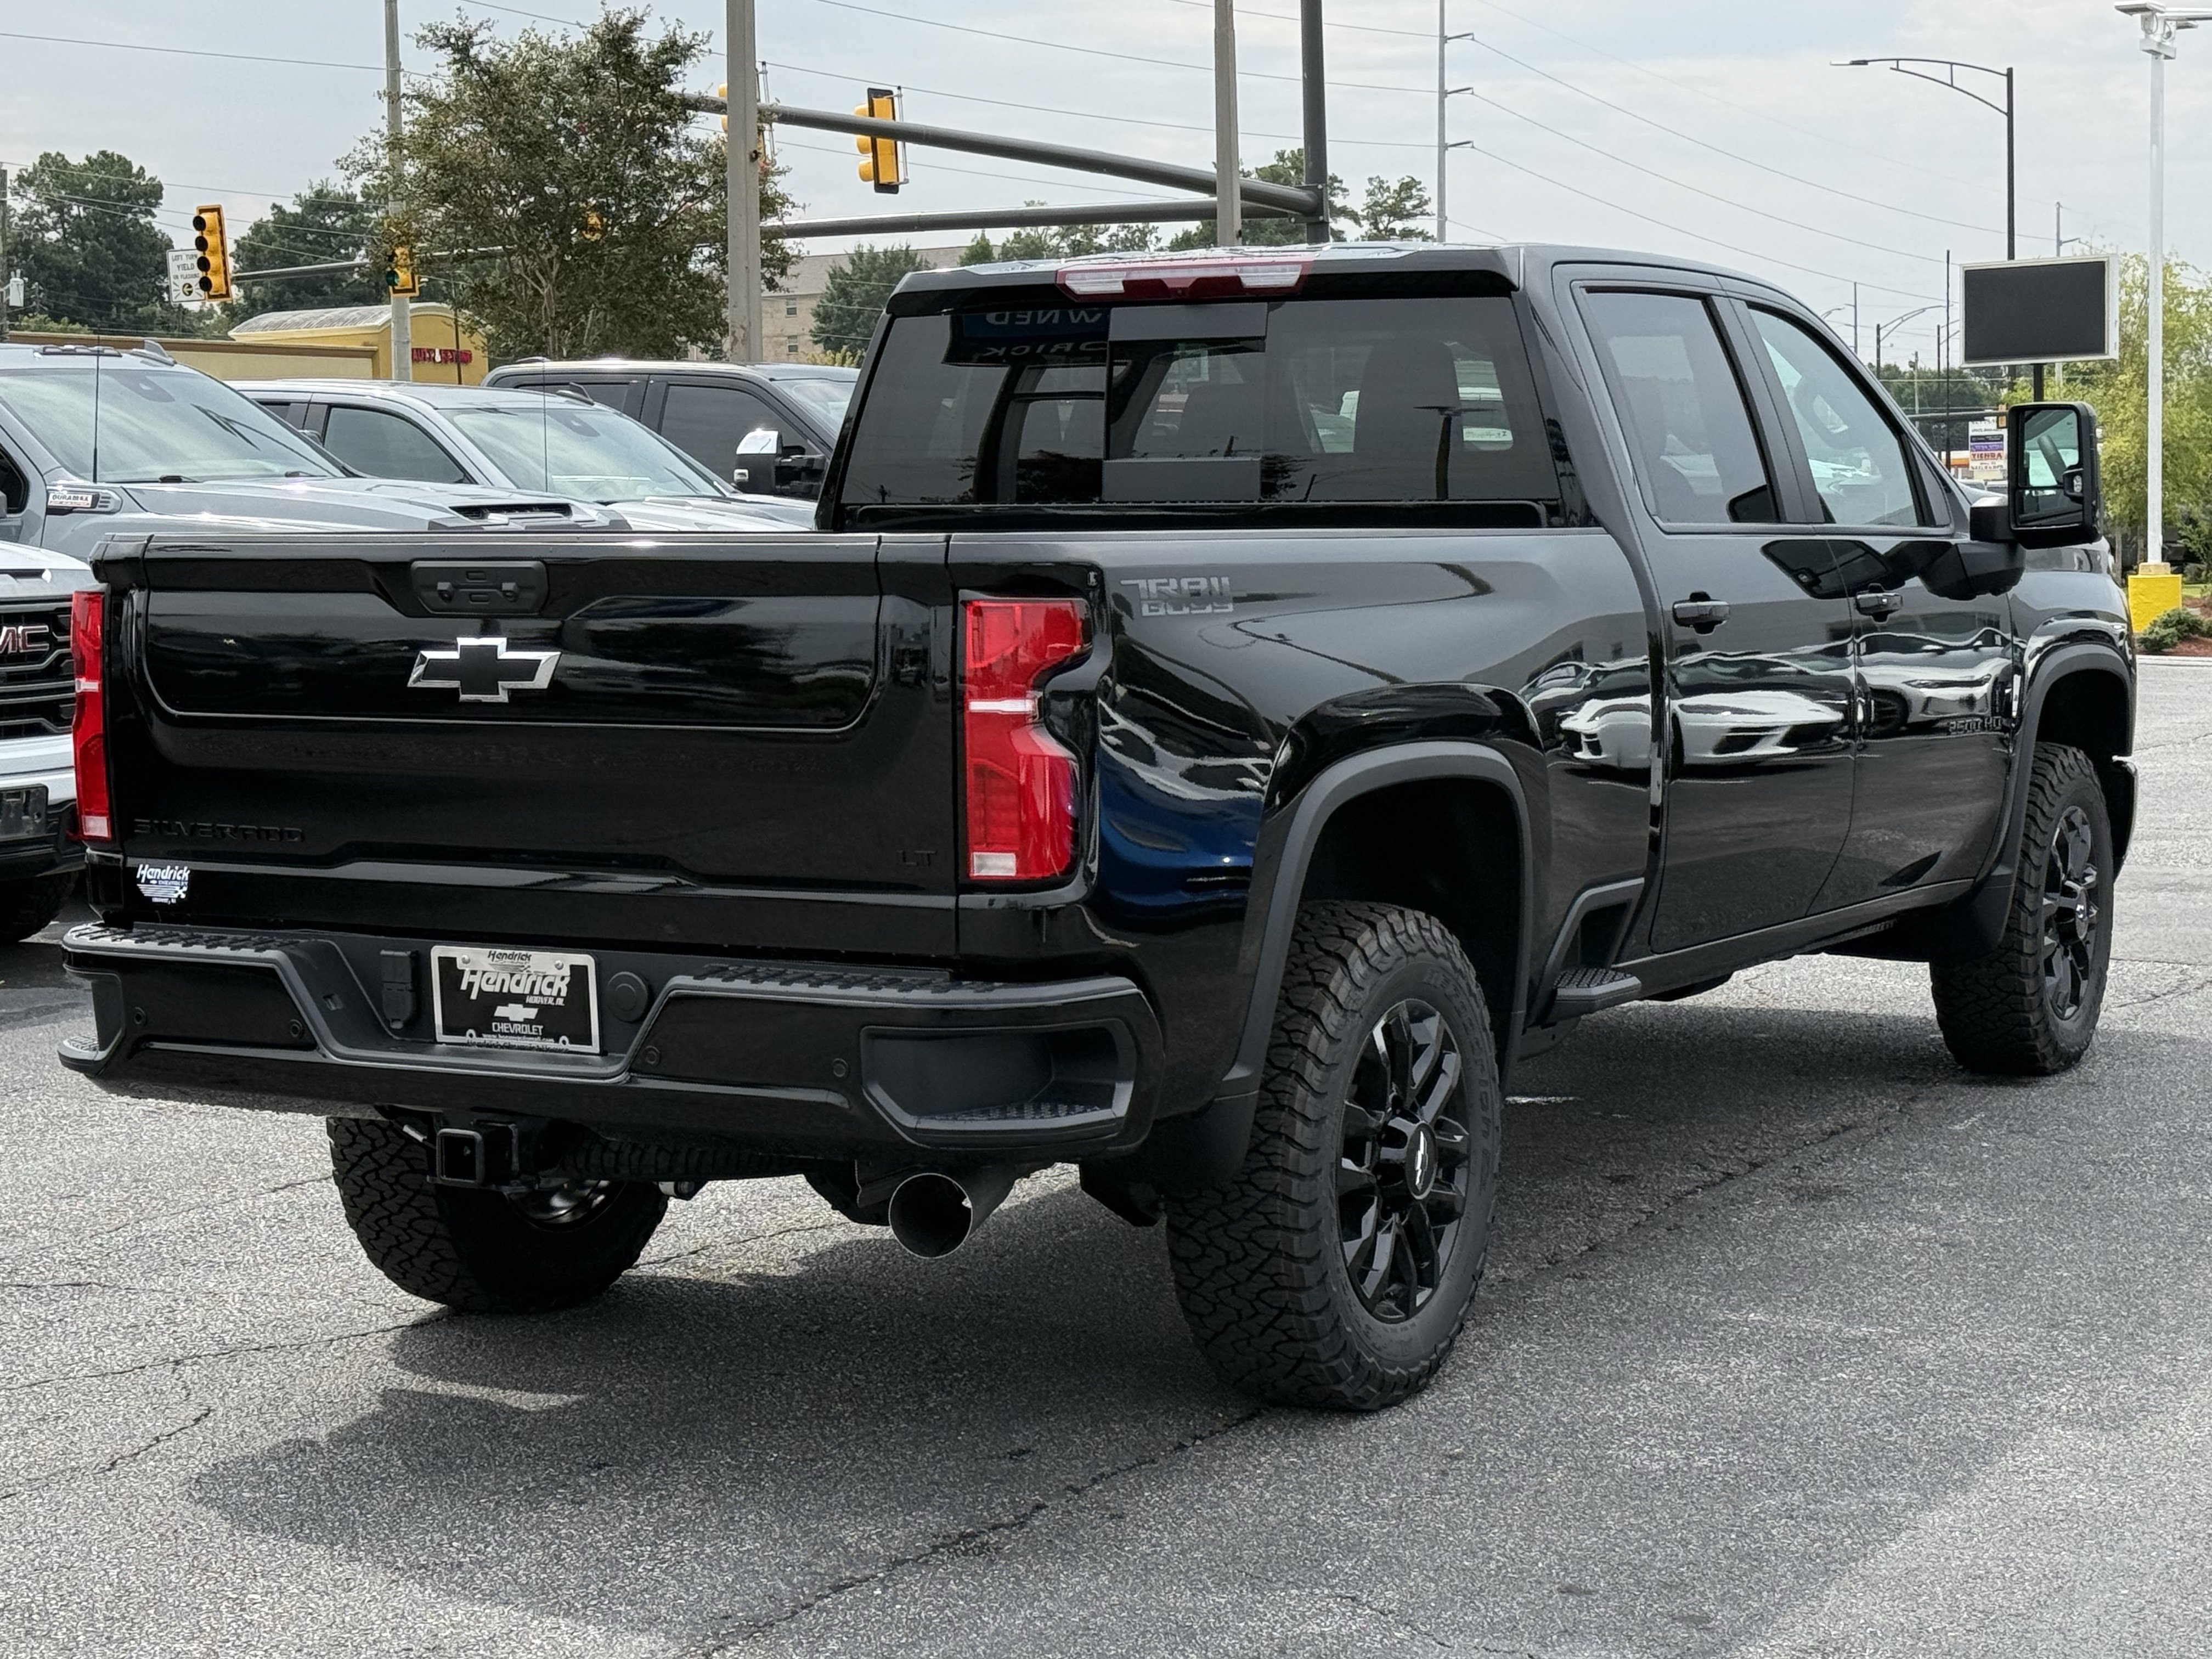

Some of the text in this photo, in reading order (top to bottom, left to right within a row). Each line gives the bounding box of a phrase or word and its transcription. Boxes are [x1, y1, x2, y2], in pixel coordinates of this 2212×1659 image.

[1120, 576, 1231, 600] TRAIL
[1141, 600, 1234, 617] BOSS
[133, 818, 305, 843] SILVERADO
[896, 850, 938, 867] LT
[136, 864, 190, 883] Hendrick
[487, 950, 532, 962] Hendrick
[460, 969, 571, 1000] Hendrick
[492, 1022, 544, 1036] CHEVROLET
